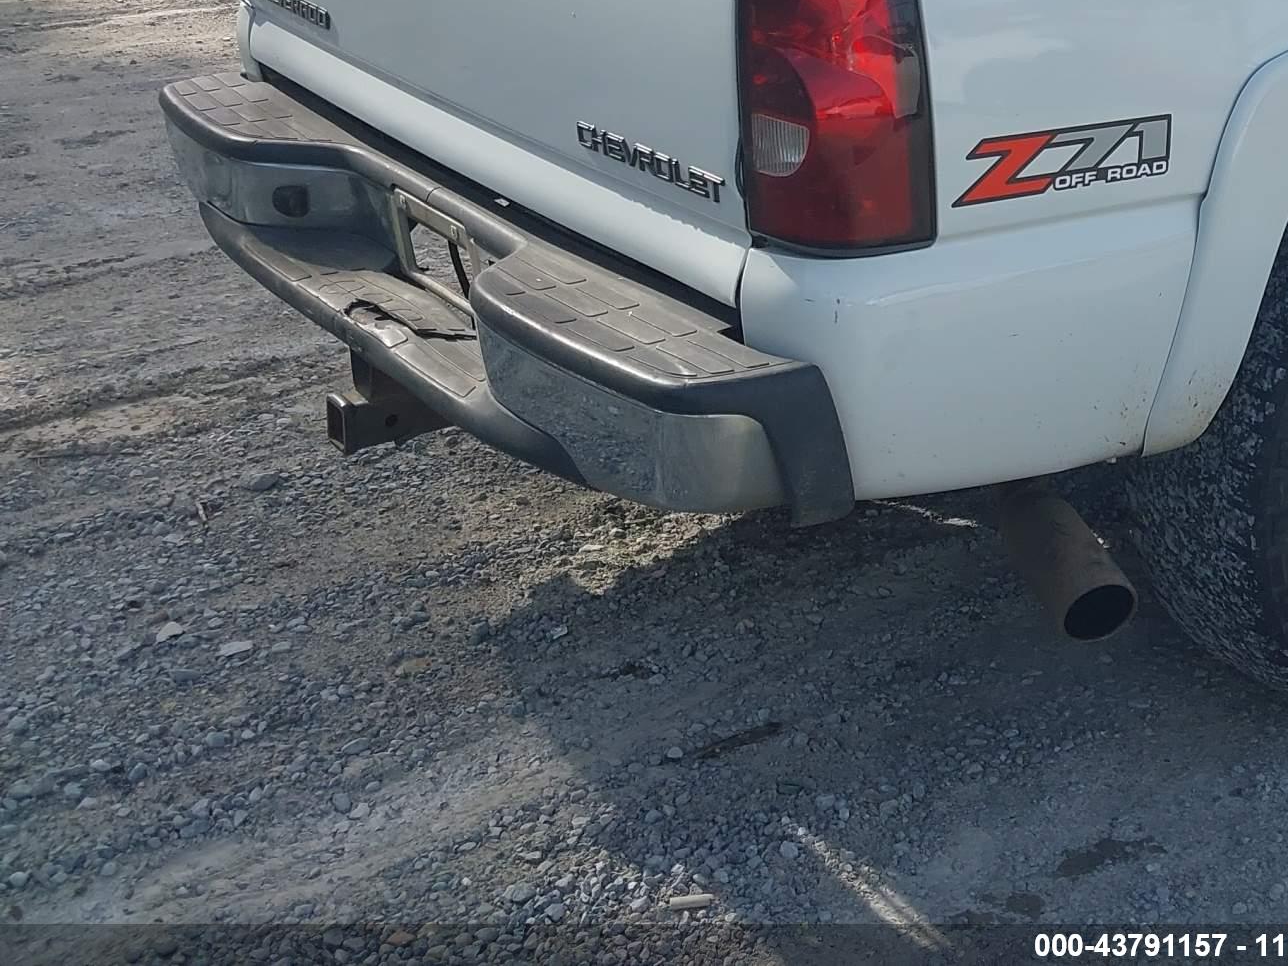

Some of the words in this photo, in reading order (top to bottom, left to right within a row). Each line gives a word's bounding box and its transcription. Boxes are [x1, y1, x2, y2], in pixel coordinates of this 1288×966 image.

[576, 120, 725, 203] CHEVROLET
[952, 114, 1172, 208] Z71
[1054, 170, 1098, 190] OFF
[1107, 160, 1168, 183] ROAD
